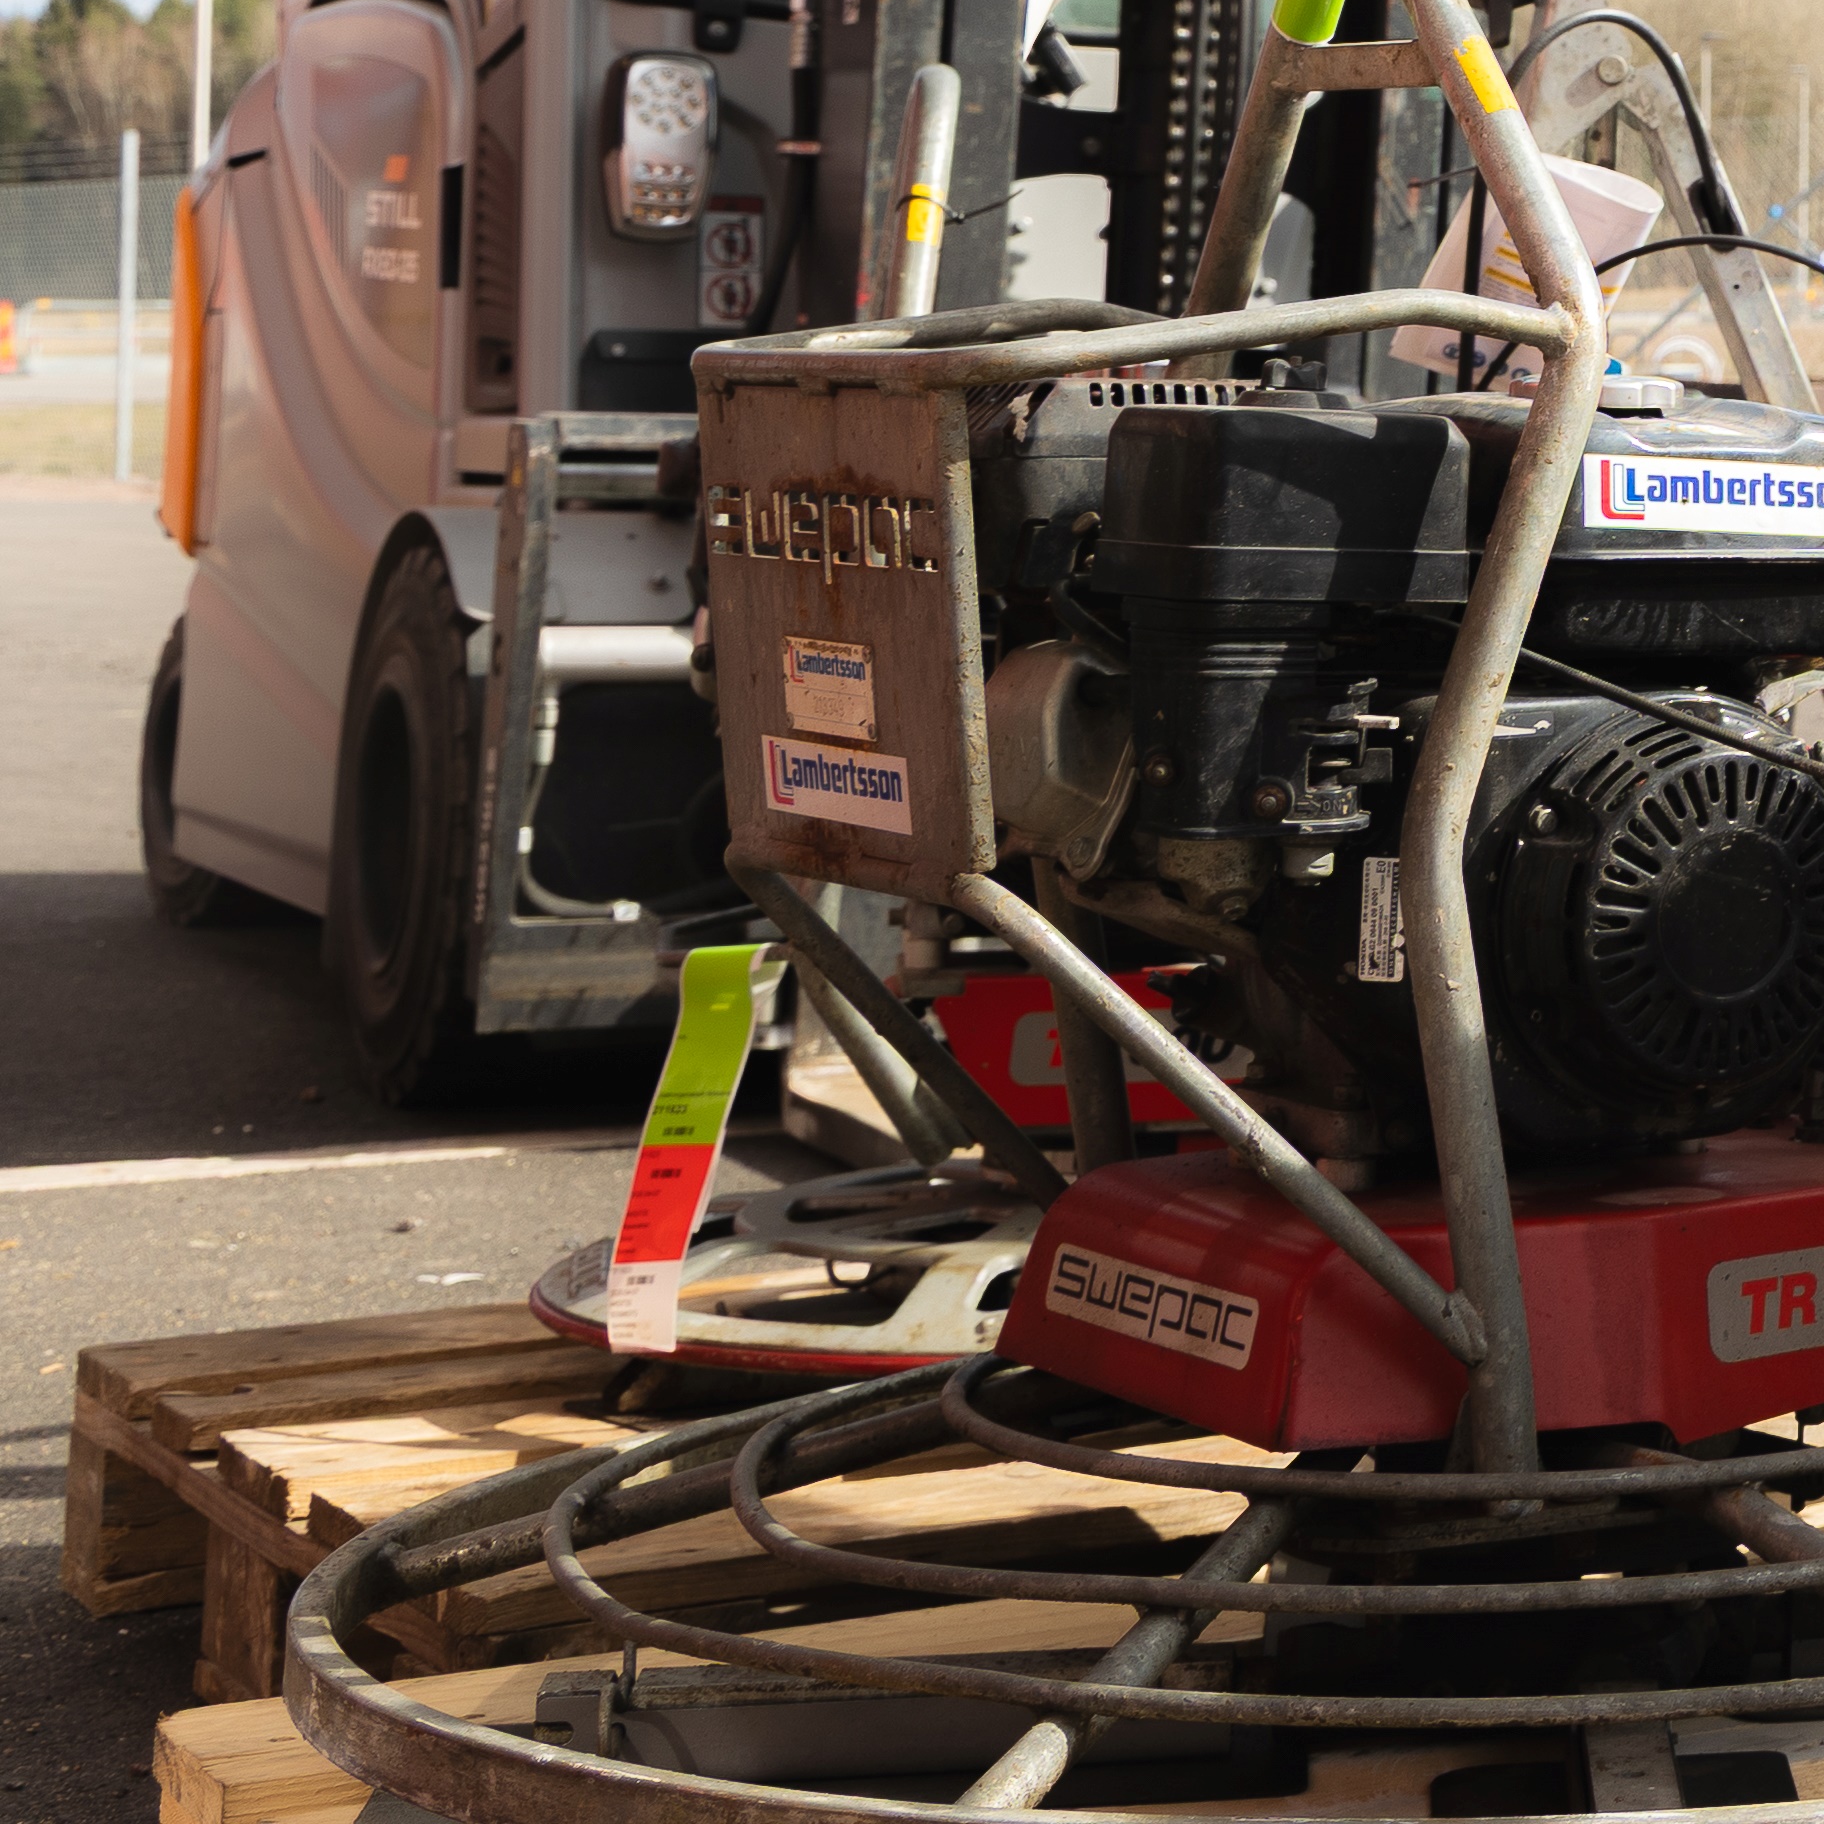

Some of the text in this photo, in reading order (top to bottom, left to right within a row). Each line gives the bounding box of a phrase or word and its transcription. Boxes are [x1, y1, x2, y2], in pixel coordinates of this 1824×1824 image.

[366, 190, 422, 229] STILL
[794, 649, 866, 682] Lambertsson
[778, 746, 904, 804] Lambertsson
[1053, 1252, 1254, 1352] swepac
[1740, 1271, 1818, 1336] TR
